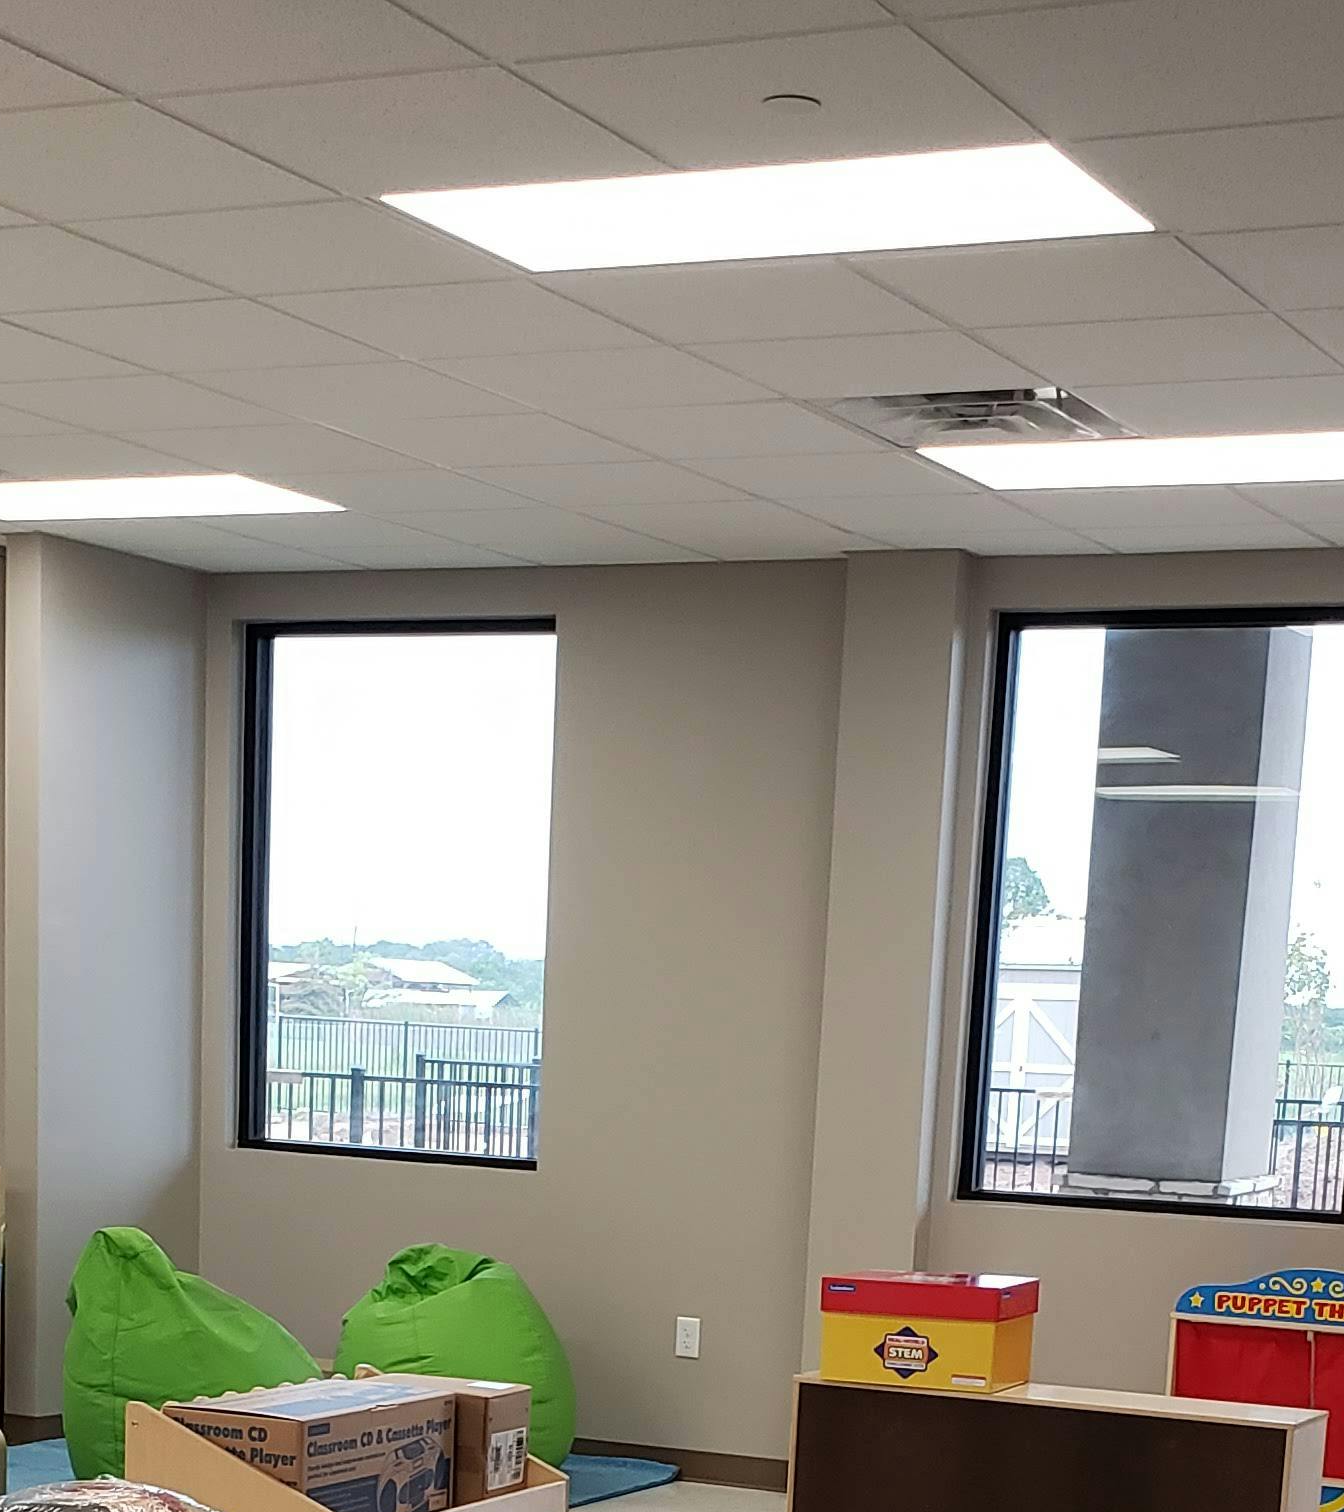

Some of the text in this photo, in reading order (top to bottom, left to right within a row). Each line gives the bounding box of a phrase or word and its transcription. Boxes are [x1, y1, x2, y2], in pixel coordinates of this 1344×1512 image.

[1215, 1292, 1308, 1317] PUPPET
[889, 1347, 923, 1360] STEM
[247, 1426, 268, 1443] CD
[307, 1417, 452, 1458] Classroom CD & Cassette Player
[250, 1447, 297, 1469] Player
